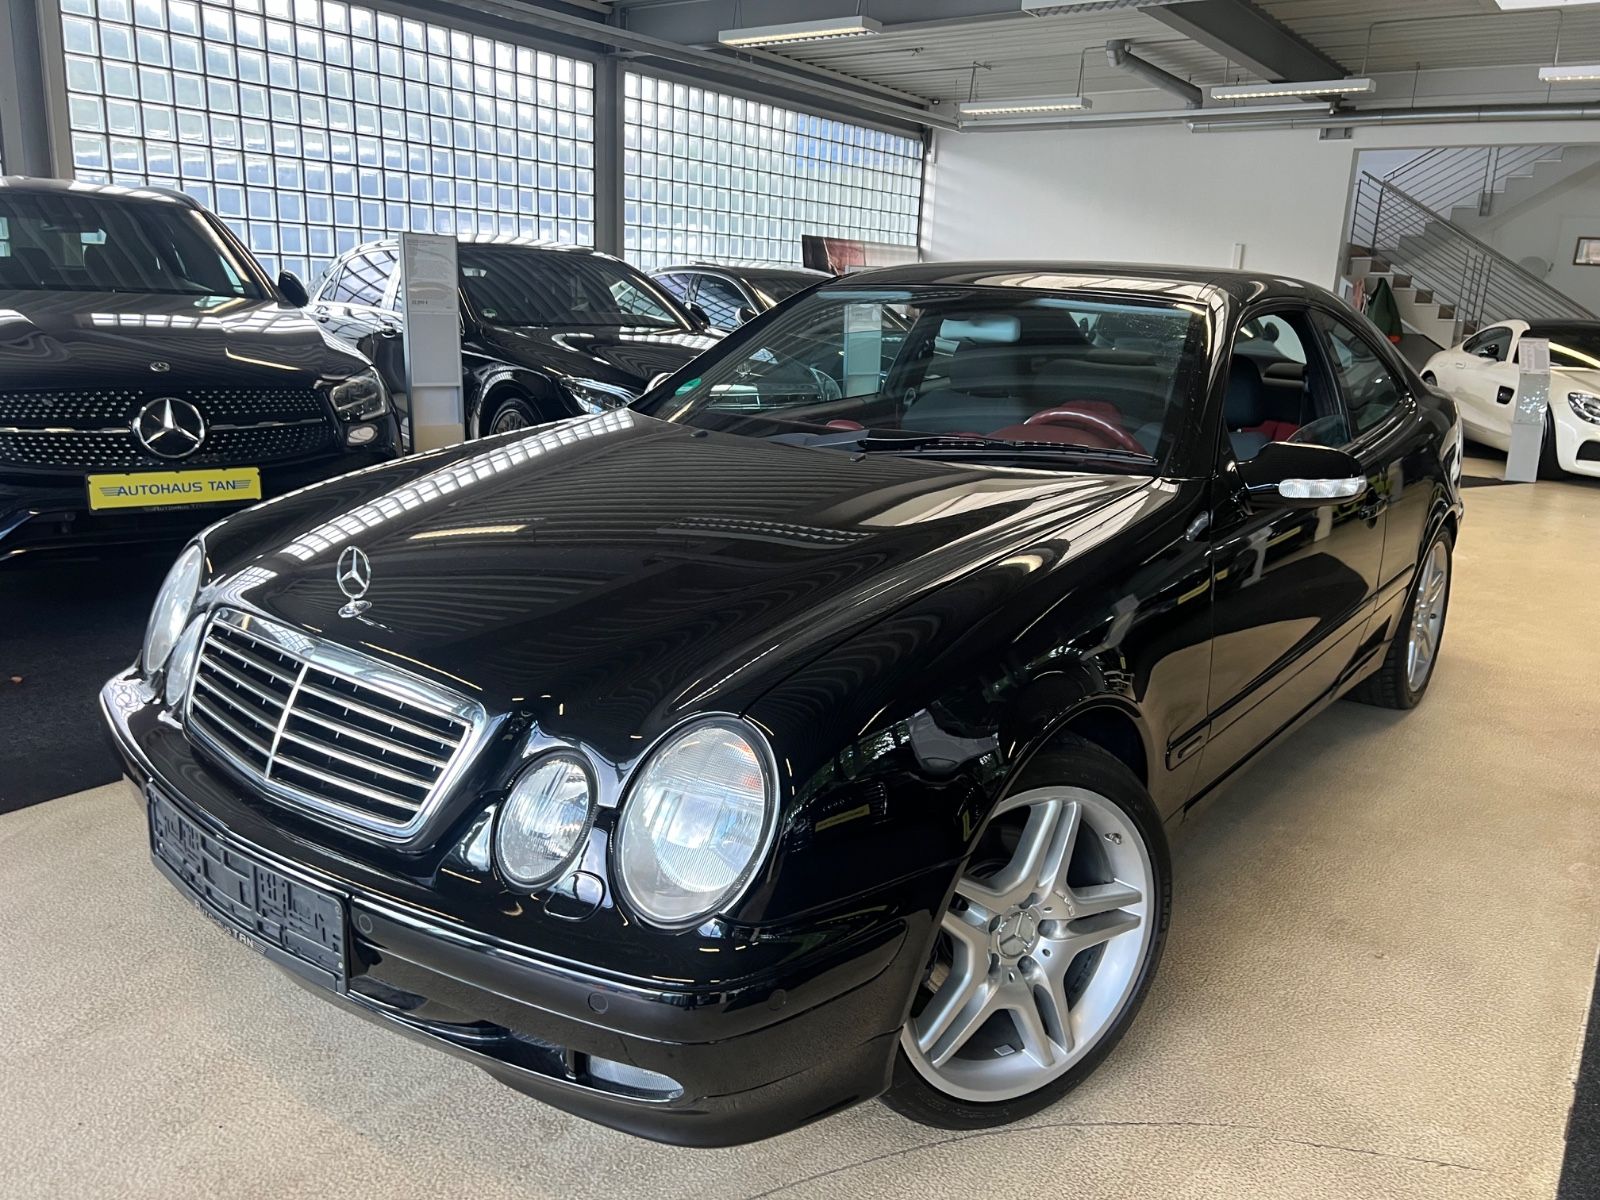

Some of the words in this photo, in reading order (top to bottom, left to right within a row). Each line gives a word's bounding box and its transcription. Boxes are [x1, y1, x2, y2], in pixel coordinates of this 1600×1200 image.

[117, 482, 203, 497] AUTOHAUS
[208, 480, 236, 491] TAN
[232, 928, 254, 948] TAN
